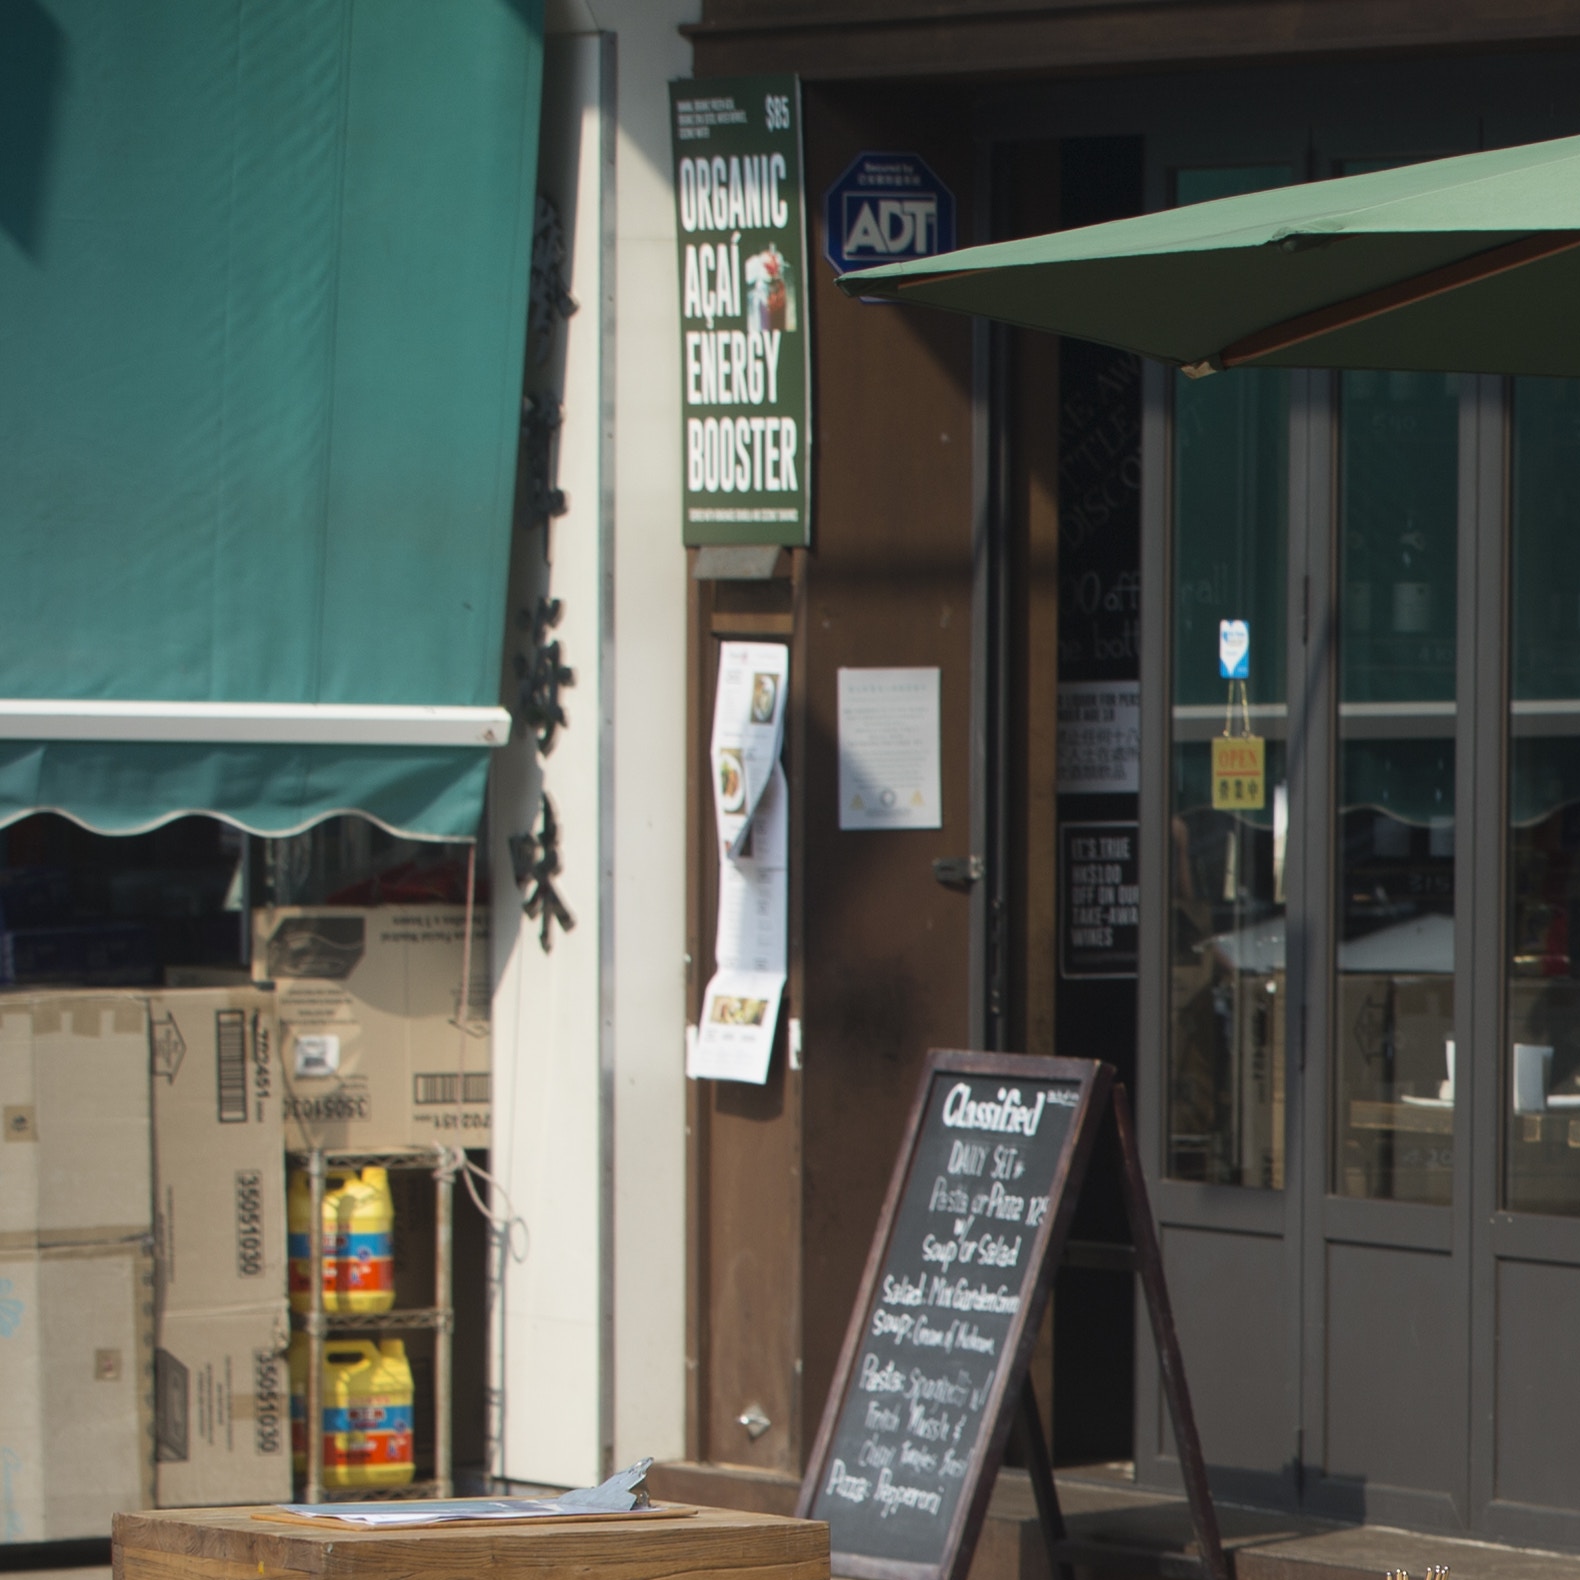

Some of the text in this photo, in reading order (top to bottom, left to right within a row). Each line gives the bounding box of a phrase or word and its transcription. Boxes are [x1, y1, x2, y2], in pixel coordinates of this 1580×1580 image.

[765, 94, 789, 132] $85
[680, 152, 788, 232] ORGANIC
[846, 200, 937, 255] ADT
[684, 232, 742, 329] AÇAÍ
[686, 329, 781, 404] ENERGY
[687, 416, 799, 492] BOOSTER
[1219, 749, 1258, 769] OPEN
[1072, 864, 1122, 884] HK$100
[1099, 836, 1131, 860] TRUE
[943, 1082, 1046, 1136] Classified
[238, 1174, 261, 1276] 35051030
